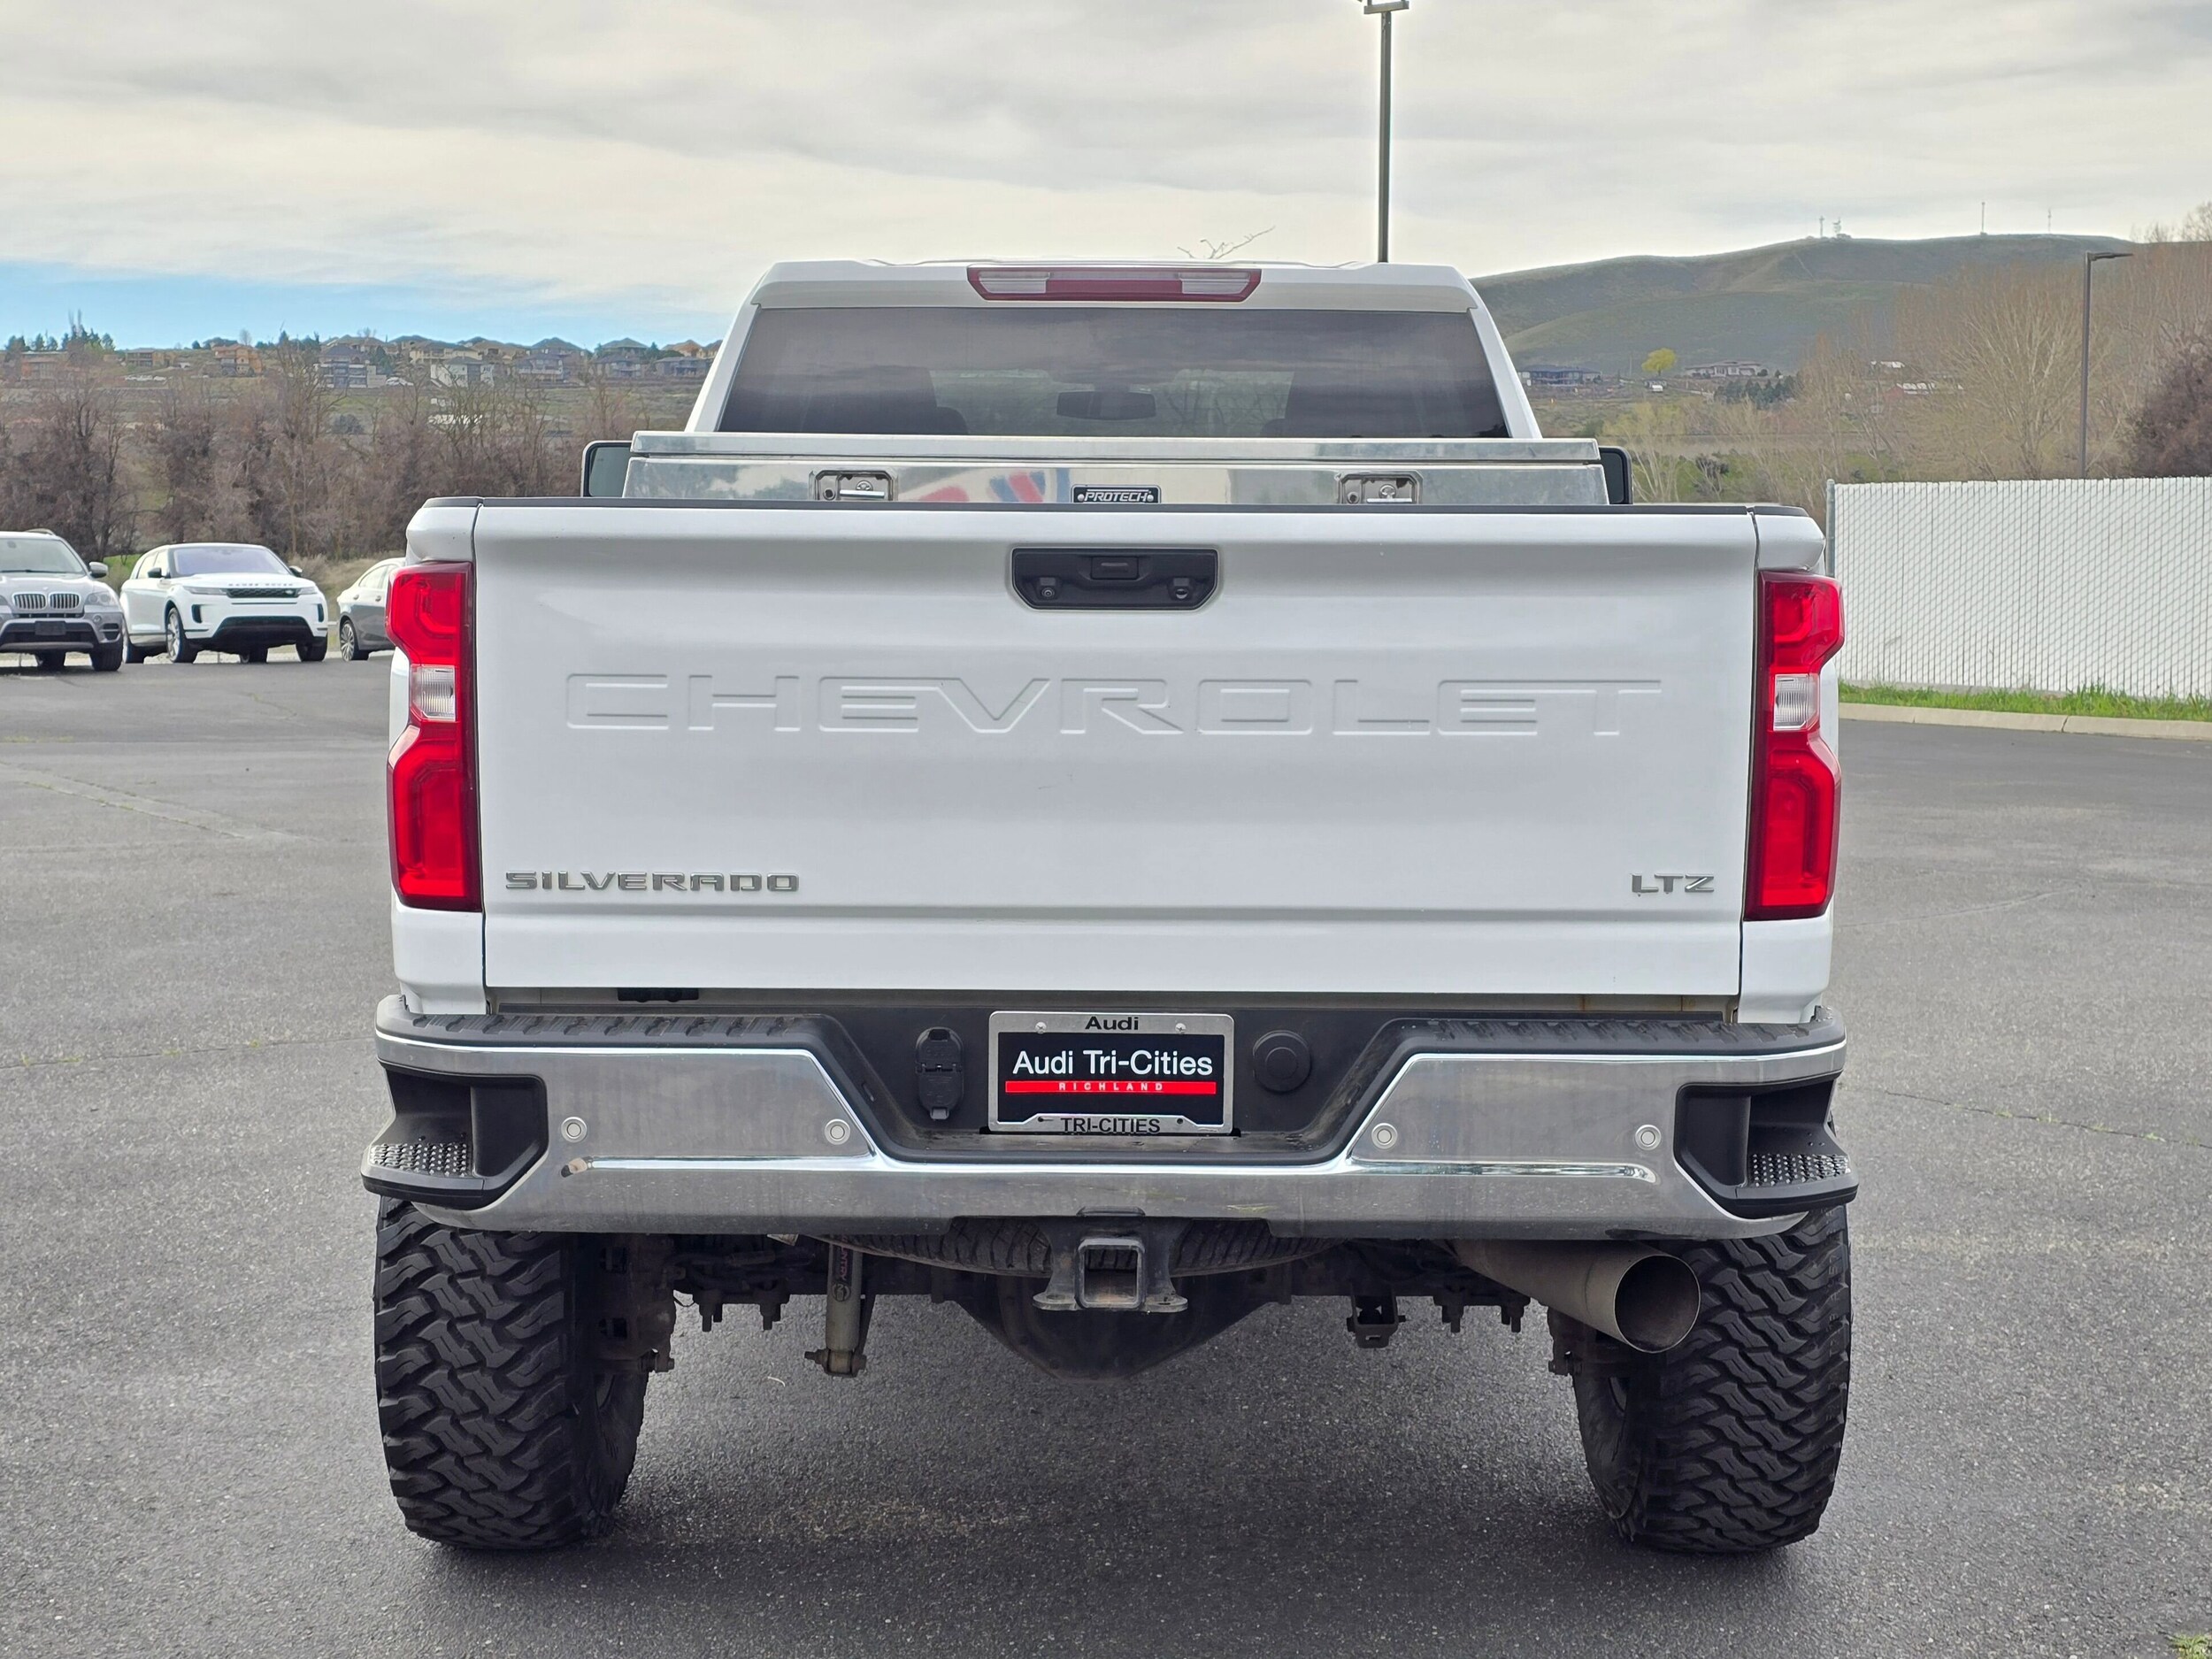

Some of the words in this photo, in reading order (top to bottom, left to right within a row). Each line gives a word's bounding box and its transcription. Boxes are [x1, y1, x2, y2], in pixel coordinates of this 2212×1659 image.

[1084, 492, 1148, 502] PROTECH
[566, 673, 1662, 735] CHEVROLET
[505, 871, 800, 892] SILVERADO
[1631, 873, 1715, 893] LTZ
[1084, 1016, 1140, 1031] Audi
[1012, 1049, 1074, 1075] Audi
[1082, 1049, 1213, 1076] Tri-Cities
[1058, 1082, 1164, 1092] RICHLAND
[1061, 1118, 1161, 1133] TRI-CITIES
